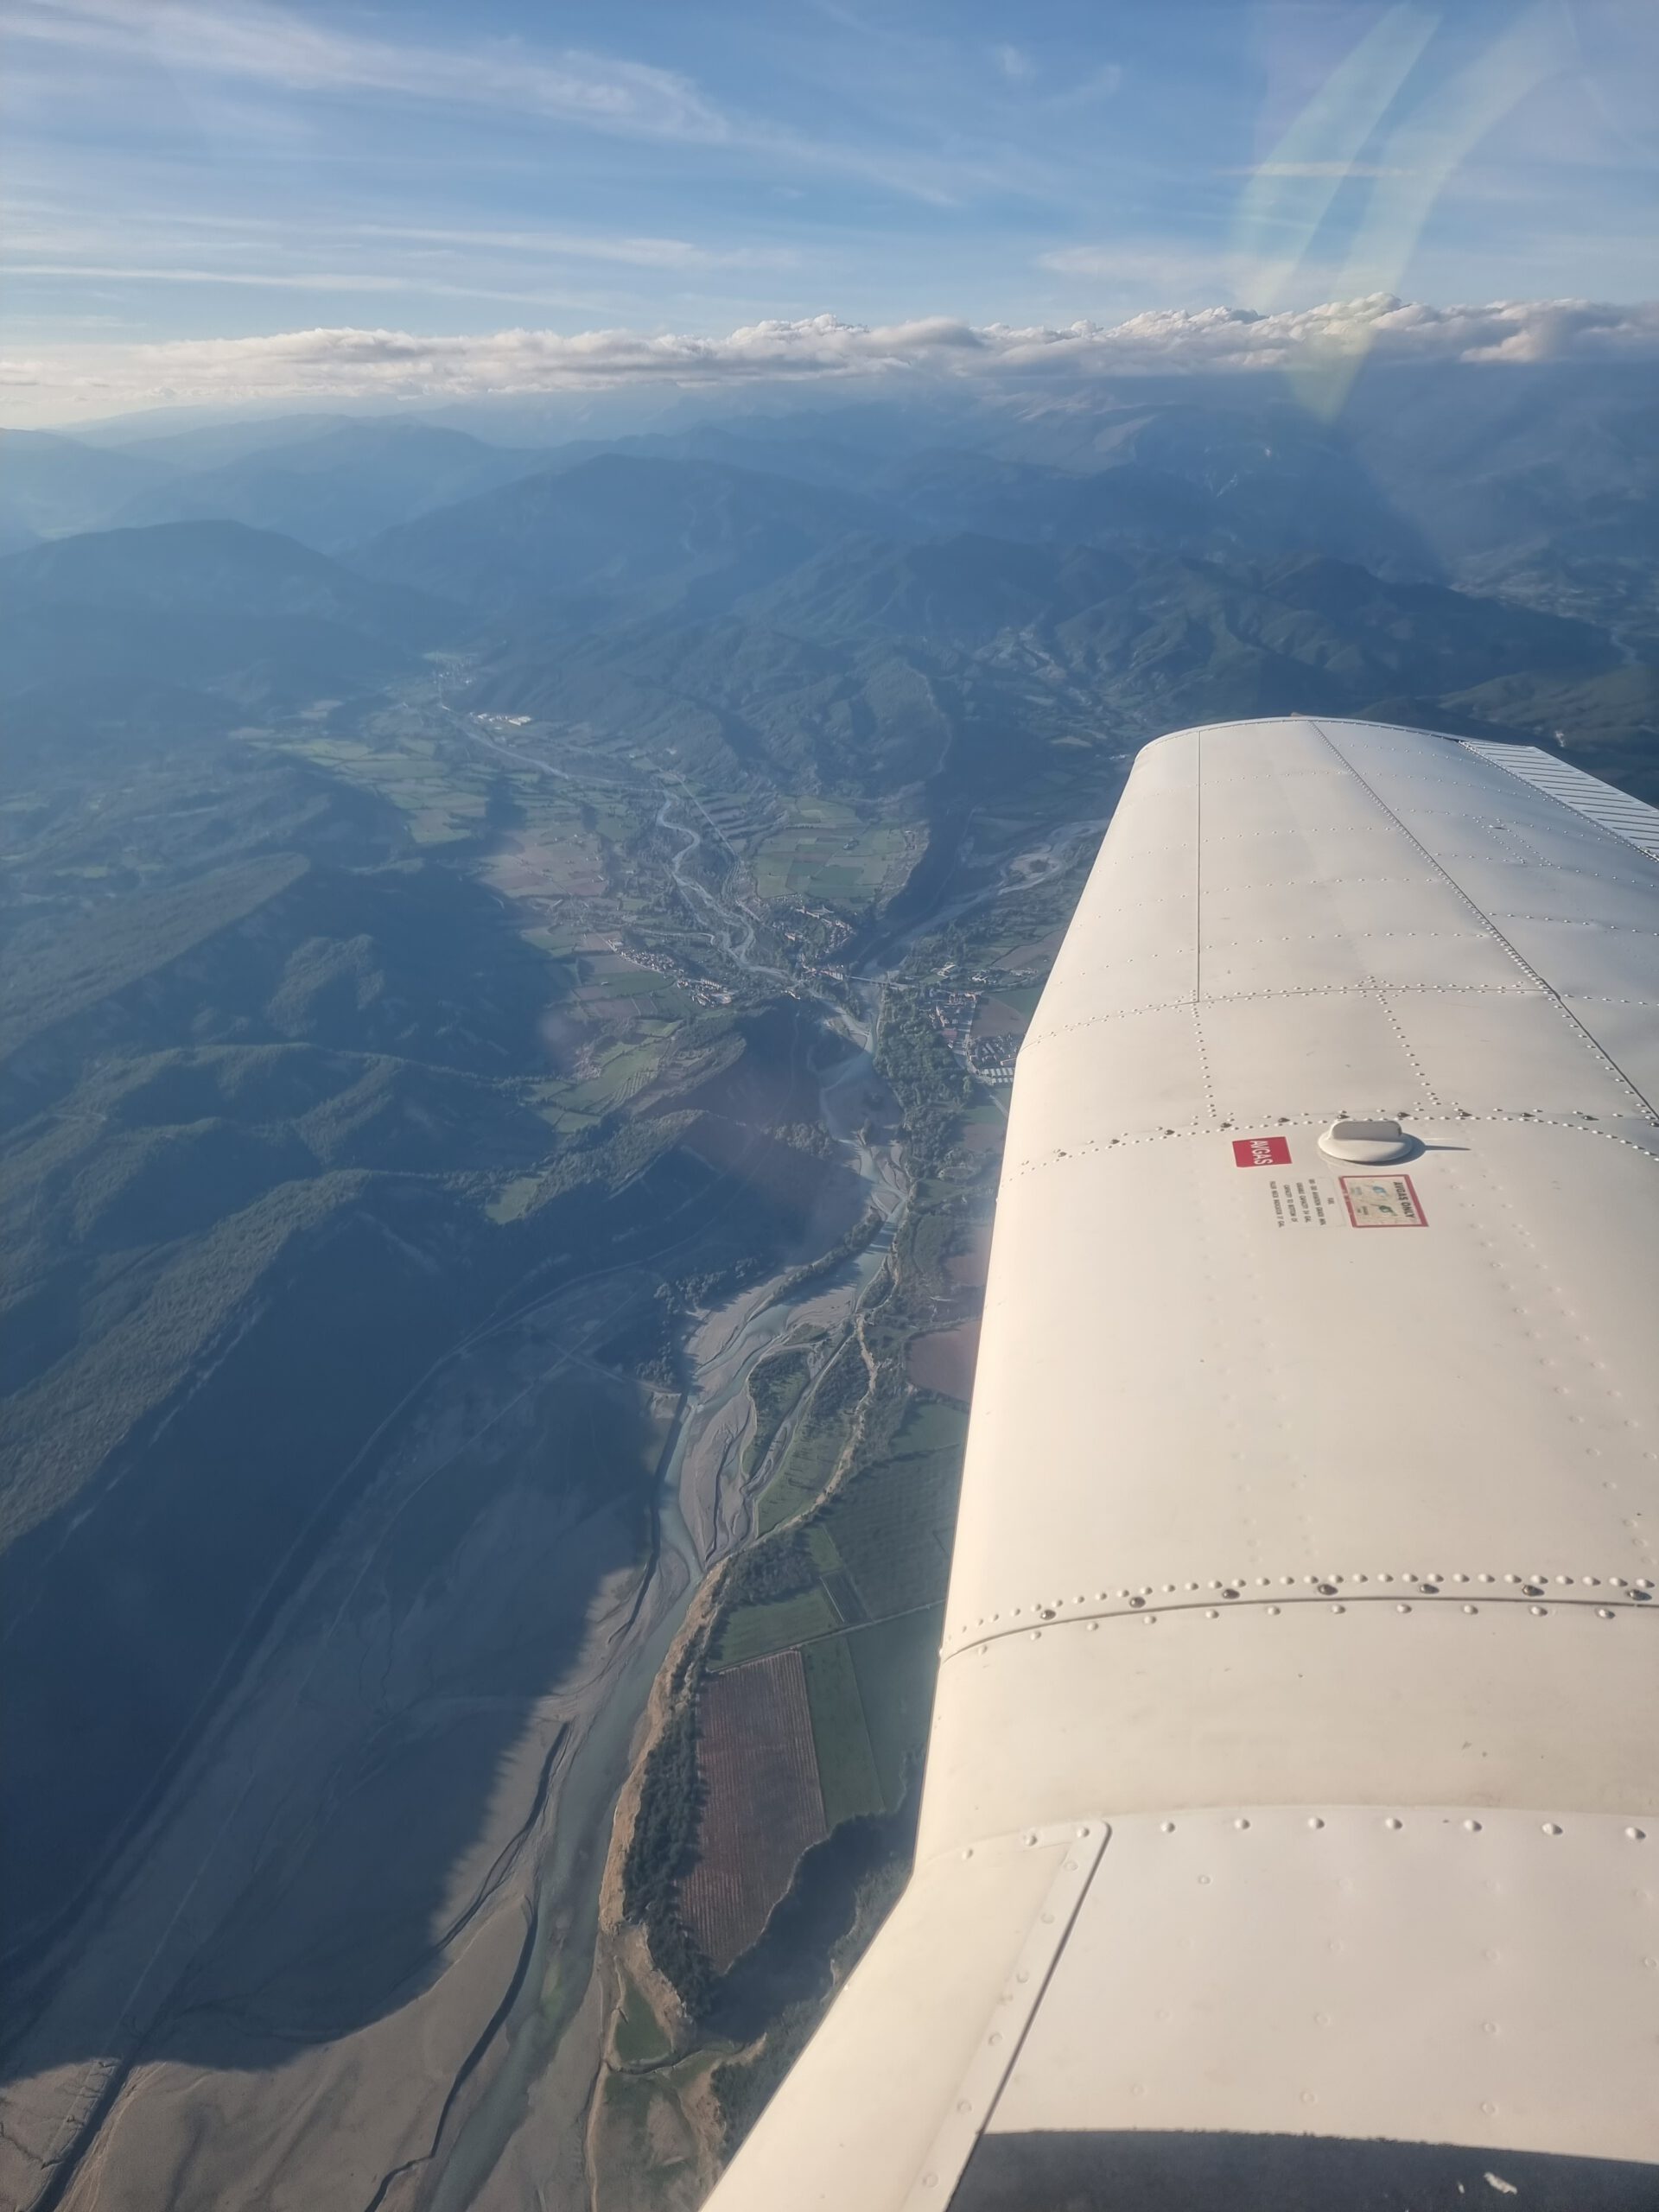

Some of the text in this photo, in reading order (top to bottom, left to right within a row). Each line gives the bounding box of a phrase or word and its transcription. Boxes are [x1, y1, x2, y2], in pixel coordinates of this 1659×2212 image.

[1250, 1141, 1274, 1165] AVGAS
[1393, 1181, 1415, 1218] AVGAS ONLY
